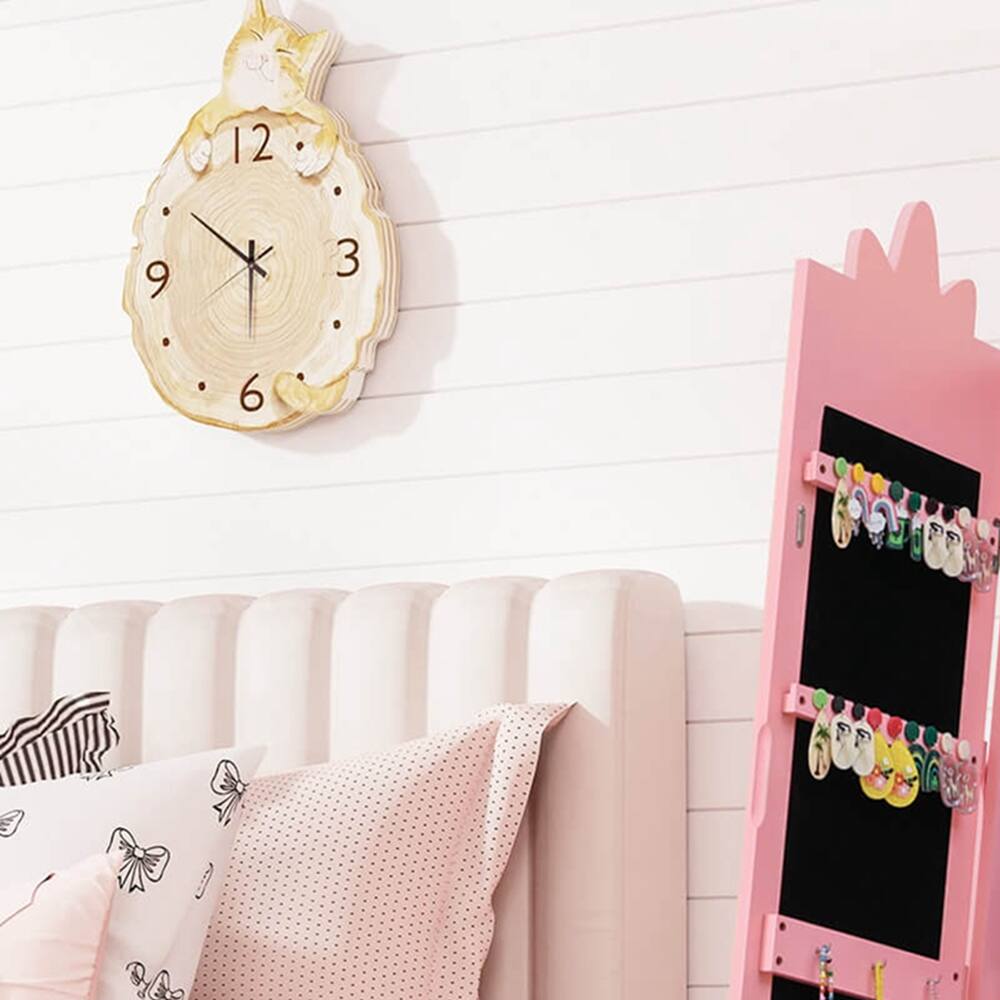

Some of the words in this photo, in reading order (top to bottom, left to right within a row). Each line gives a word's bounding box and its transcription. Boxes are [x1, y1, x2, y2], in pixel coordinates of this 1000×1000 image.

[234, 123, 273, 164] 12
[336, 238, 359, 277] 3
[145, 260, 170, 299] 9
[239, 373, 264, 412] 6
